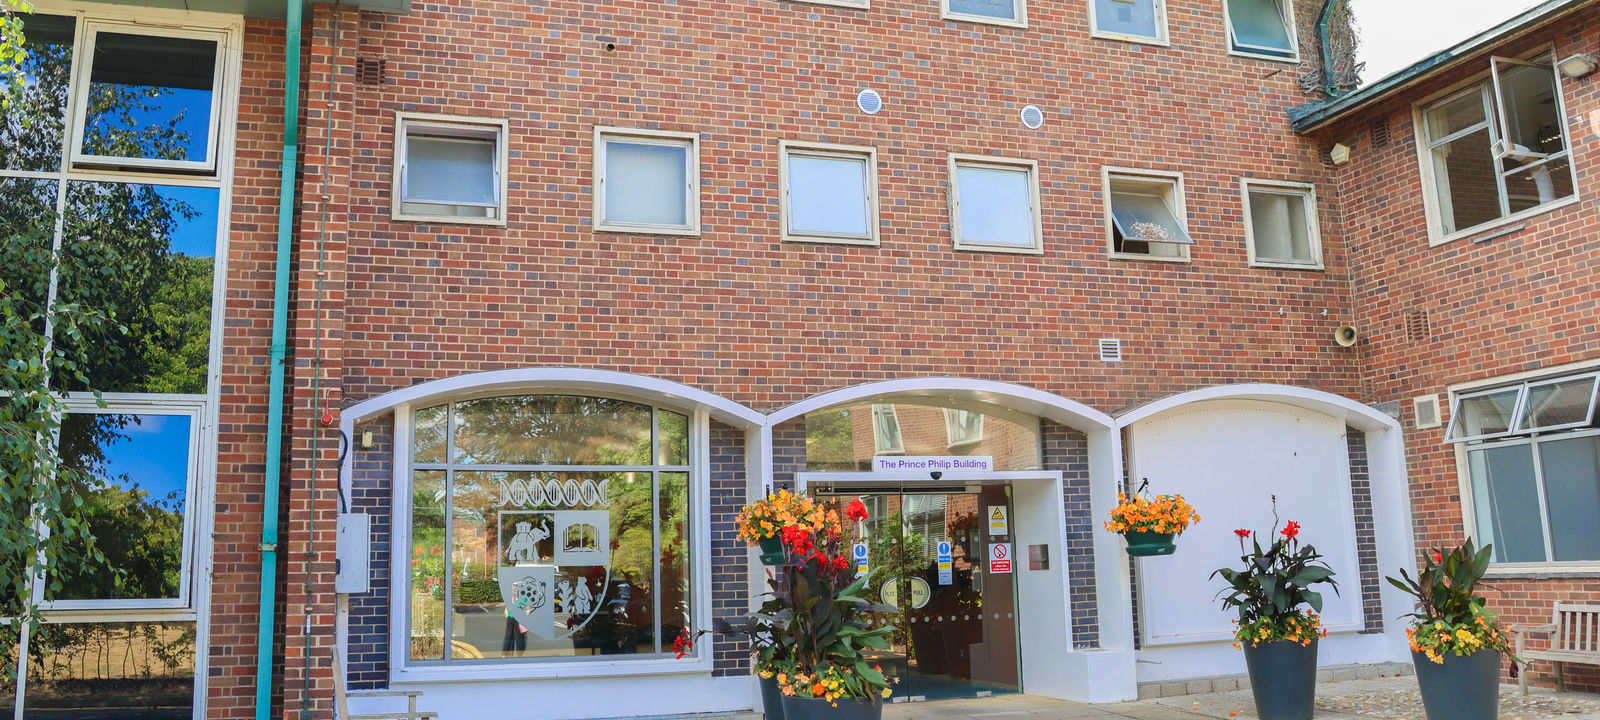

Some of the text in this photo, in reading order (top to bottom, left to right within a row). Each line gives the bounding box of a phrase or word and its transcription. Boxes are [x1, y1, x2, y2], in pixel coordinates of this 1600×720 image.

[880, 459, 987, 469] The Prince Philip Building
